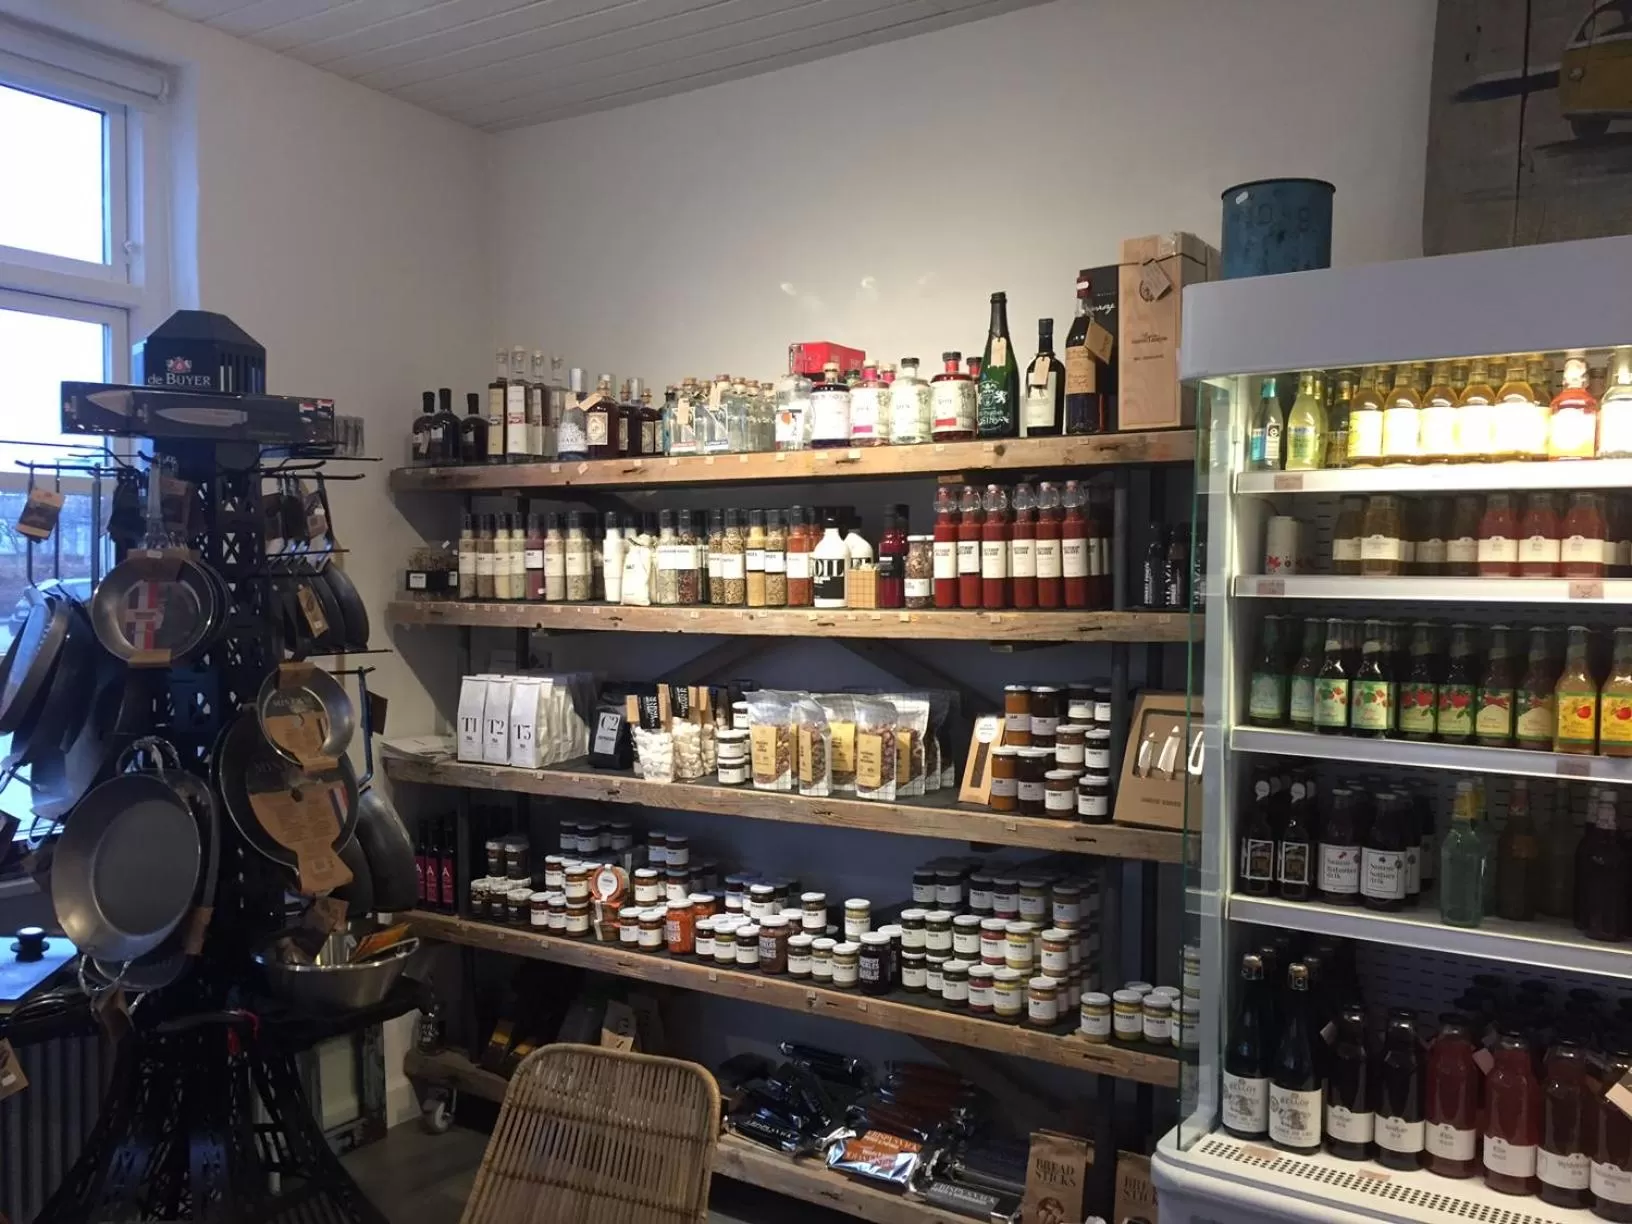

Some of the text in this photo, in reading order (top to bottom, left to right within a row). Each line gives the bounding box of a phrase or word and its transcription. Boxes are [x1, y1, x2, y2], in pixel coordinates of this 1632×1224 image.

[147, 372, 212, 387] de BUYER
[1035, 1158, 1075, 1175] BREAD
[1034, 1169, 1077, 1187] STICKS
